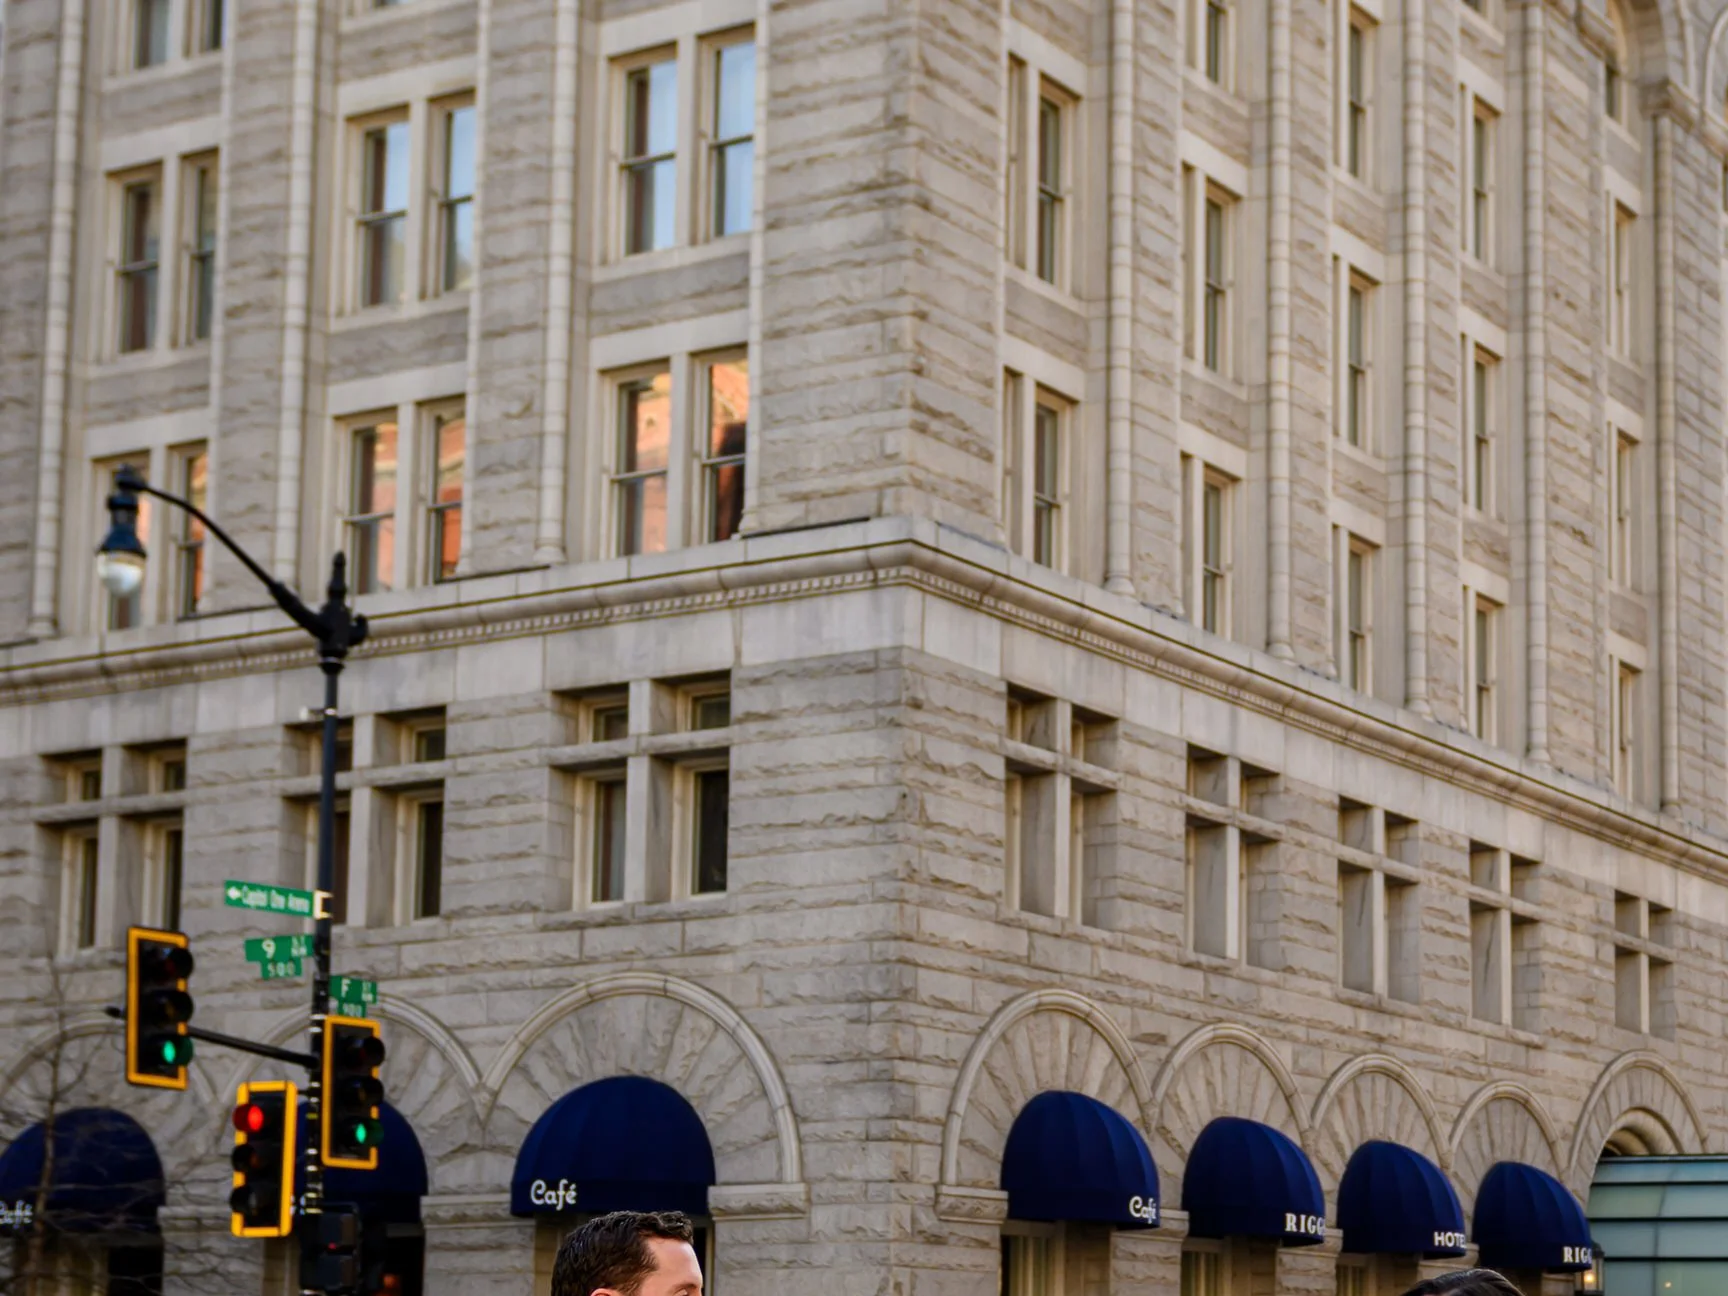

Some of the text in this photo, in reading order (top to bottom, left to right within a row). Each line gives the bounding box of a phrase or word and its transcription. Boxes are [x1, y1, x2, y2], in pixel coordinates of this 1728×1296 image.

[262, 939, 276, 959] 9
[341, 978, 351, 998] F
[530, 1179, 577, 1211] Café
